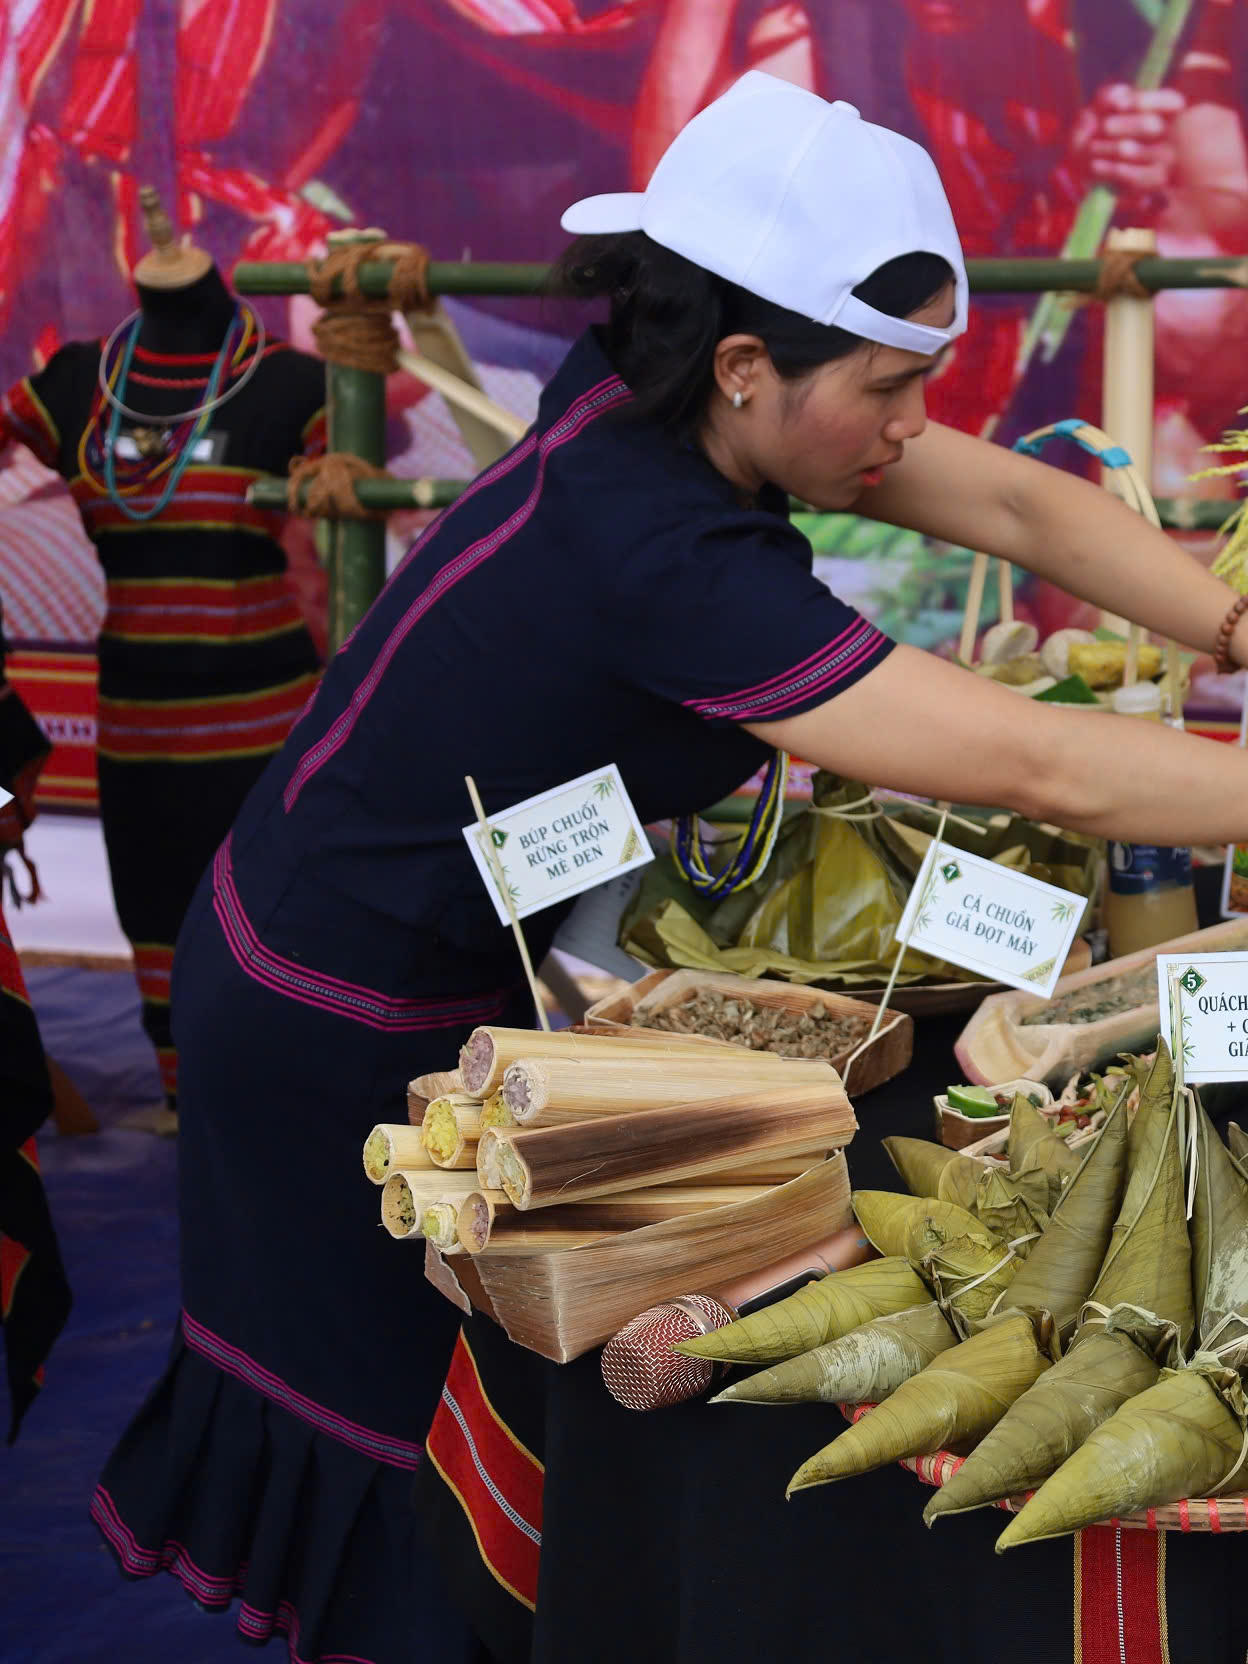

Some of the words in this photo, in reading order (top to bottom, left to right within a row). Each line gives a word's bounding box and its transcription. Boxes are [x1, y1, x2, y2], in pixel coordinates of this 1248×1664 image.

[518, 826, 549, 850] BÚP
[552, 800, 599, 834] CHUỐI
[525, 838, 568, 868] RỪNG
[569, 819, 611, 849] TRỘN
[573, 845, 604, 868] ĐEN
[947, 865, 956, 878] 7
[963, 894, 983, 913] CÁ
[974, 922, 1005, 944] ĐỌT
[1187, 973, 1197, 989] 5
[1198, 992, 1248, 1014] QUÁCH
[1227, 1021, 1237, 1033] +
